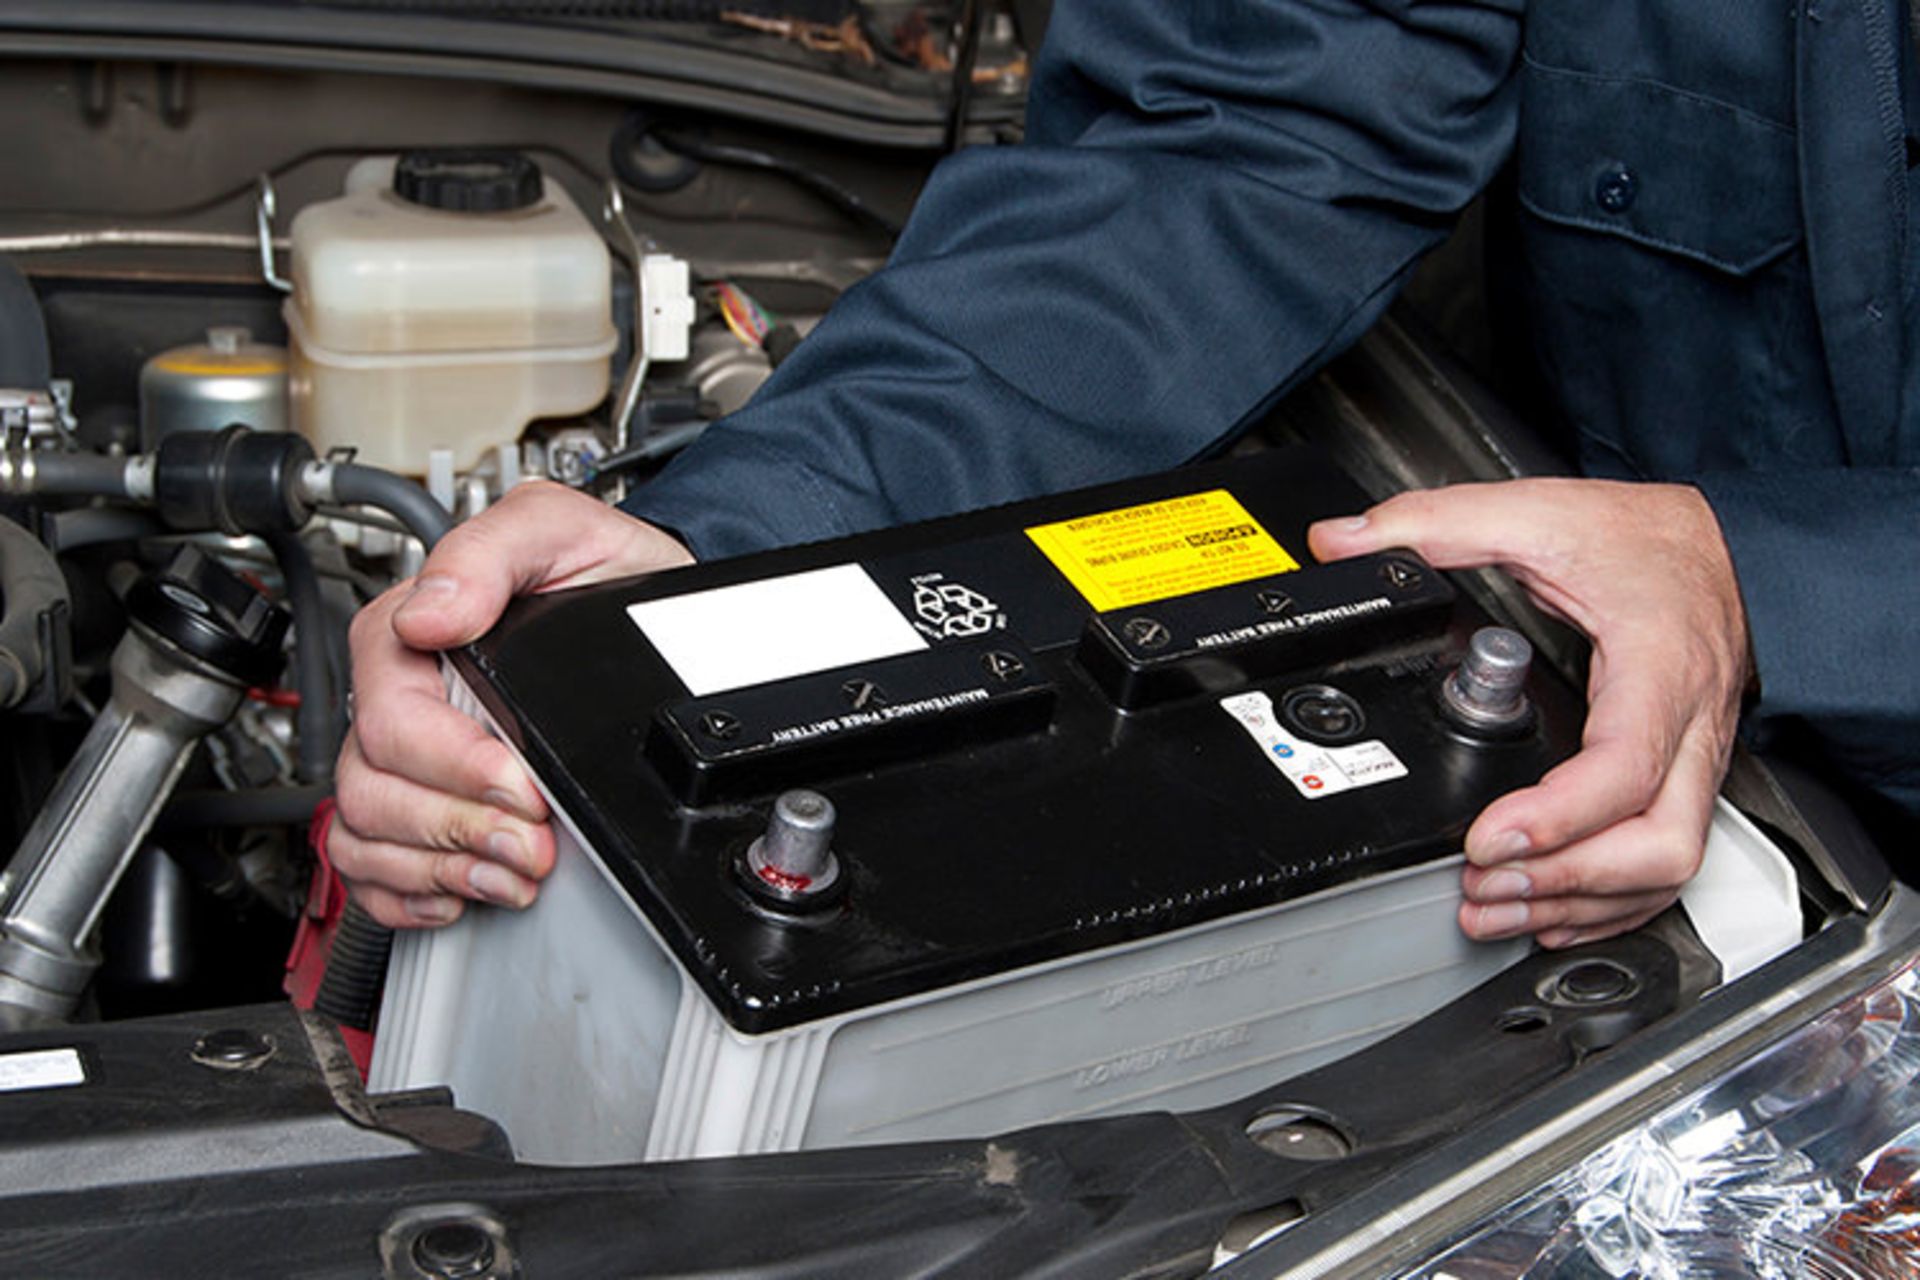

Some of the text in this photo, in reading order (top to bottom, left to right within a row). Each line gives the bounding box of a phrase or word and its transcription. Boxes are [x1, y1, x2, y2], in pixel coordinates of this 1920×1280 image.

[1195, 596, 1391, 649] MAINTENANCE FREE BATTERY
[771, 688, 989, 744] MAINTENANCE FREE BATTERY
[1197, 944, 1279, 986] LEVEL
[1073, 1024, 1252, 1092] LOWER LEVEL
